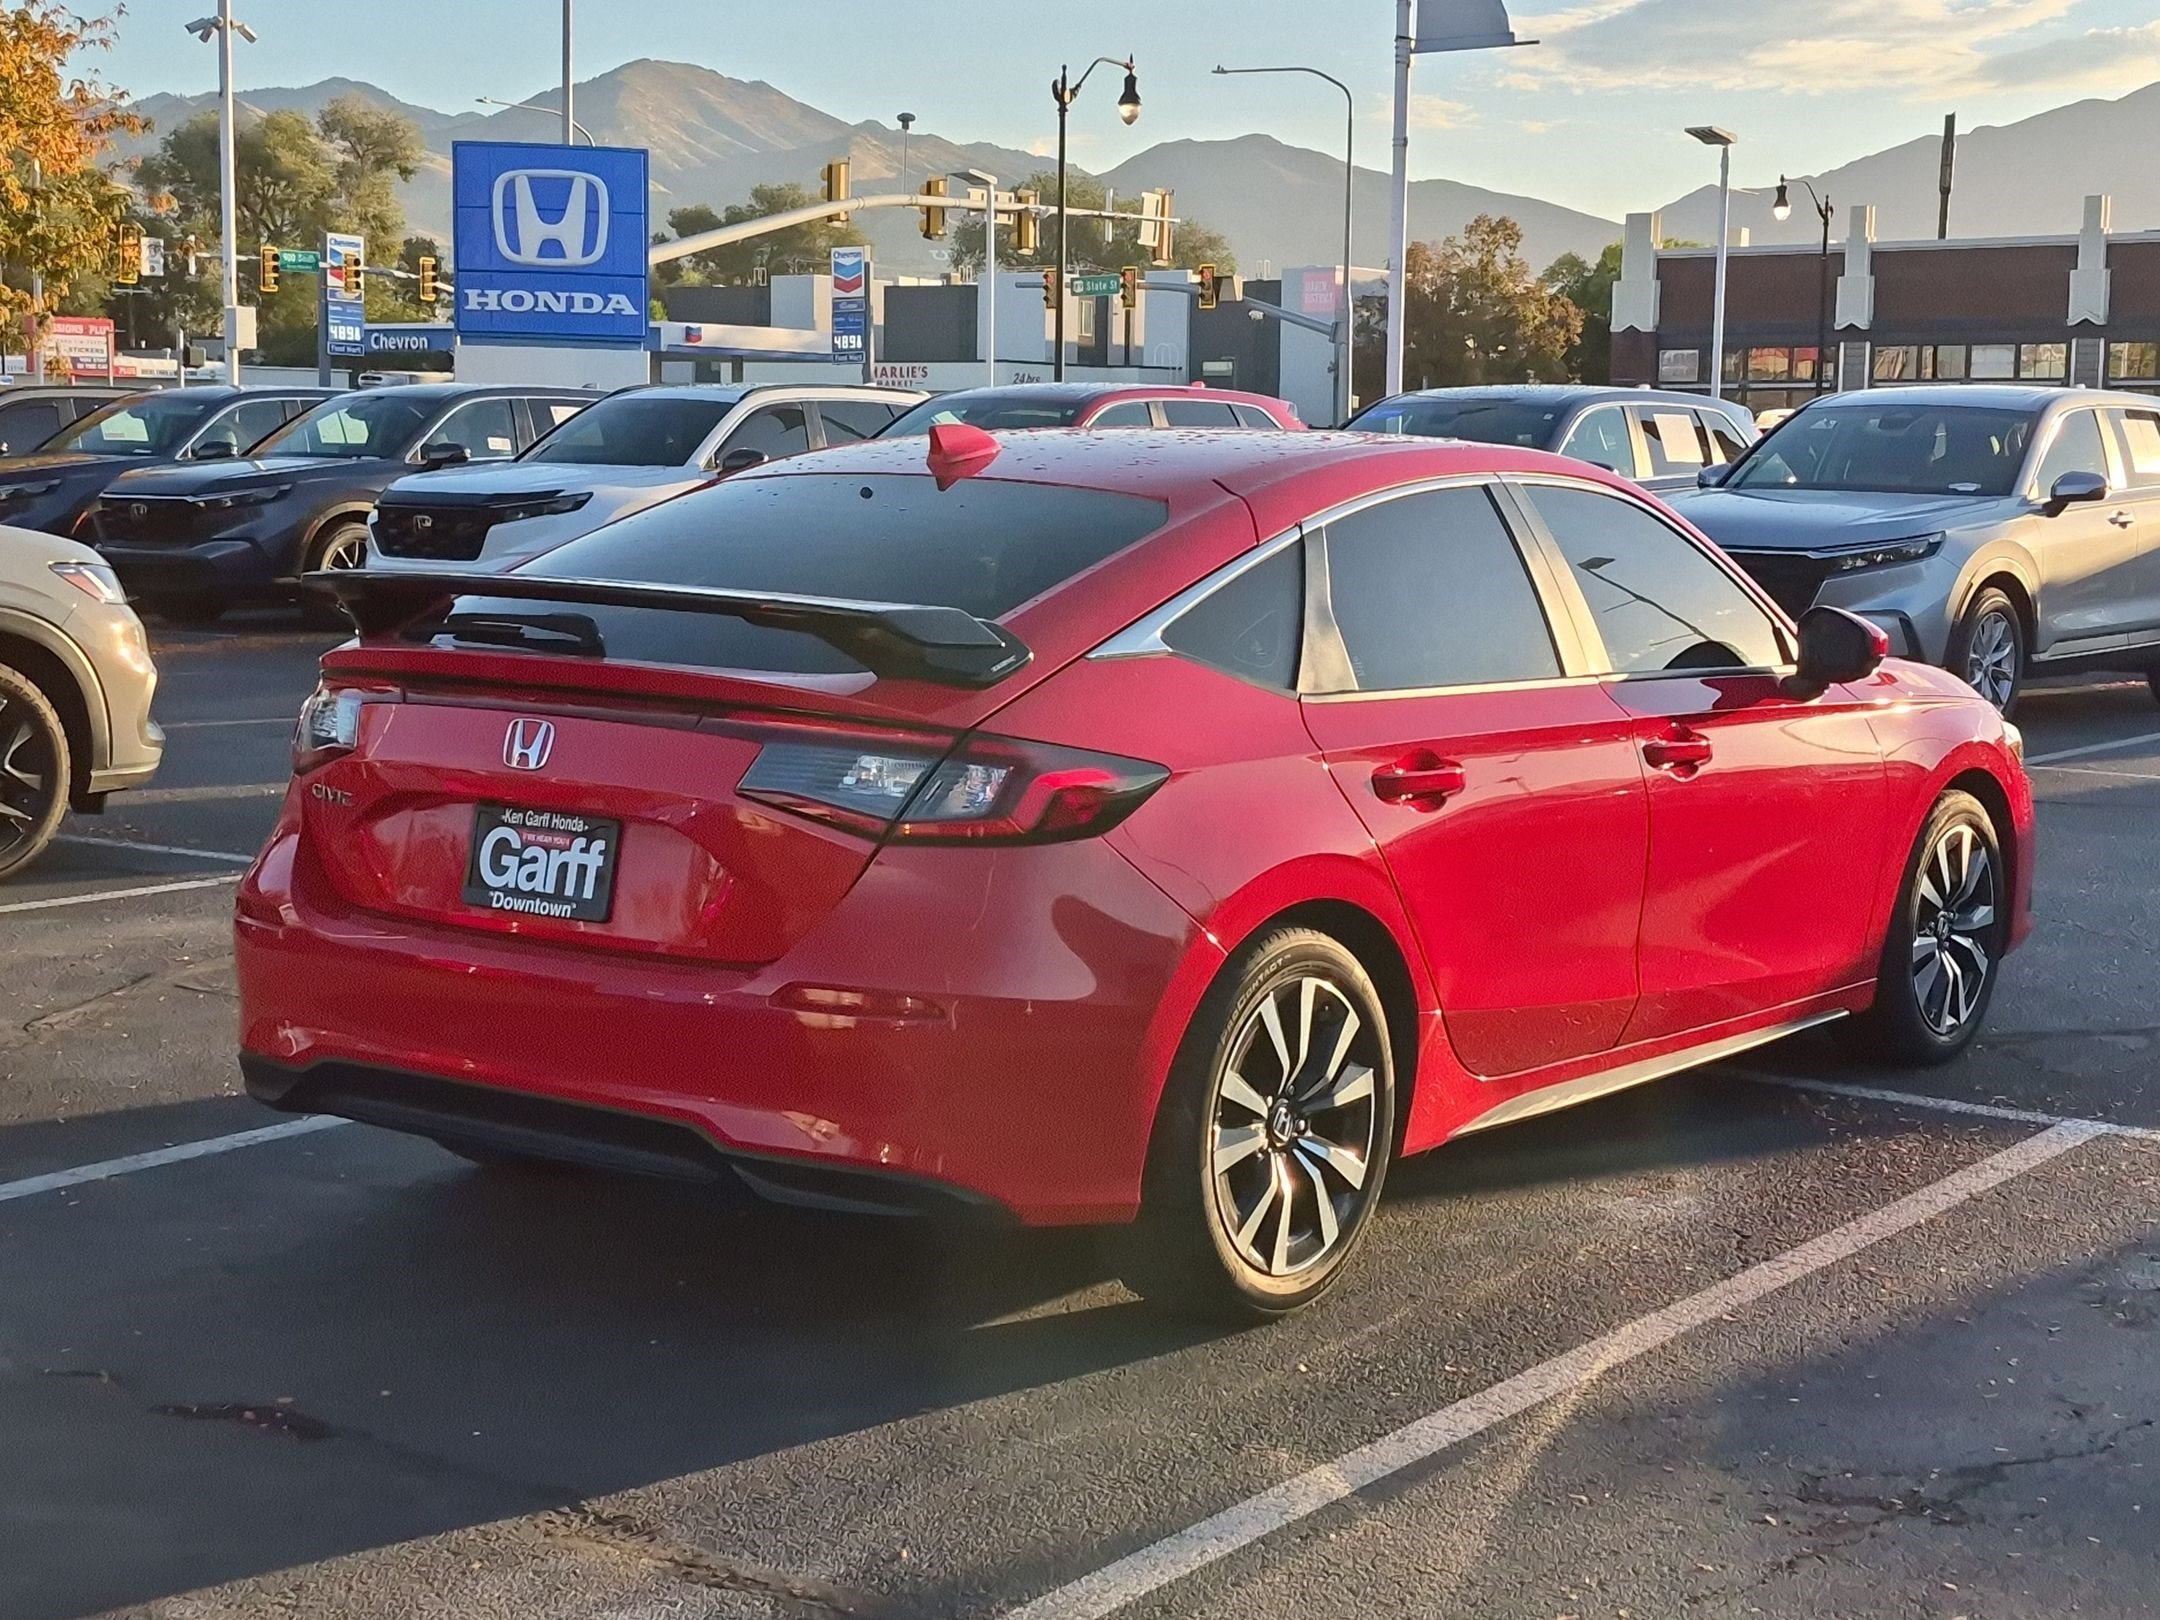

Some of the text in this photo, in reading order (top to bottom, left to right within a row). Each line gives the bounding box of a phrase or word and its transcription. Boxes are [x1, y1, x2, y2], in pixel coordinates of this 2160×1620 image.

[1086, 280, 1107, 291] State
[1109, 279, 1118, 290] St
[463, 288, 640, 316] HONDA
[370, 332, 428, 350] Chevron
[312, 783, 353, 807] CIVIC
[503, 808, 584, 832] Ken Garff Honda
[479, 826, 606, 899] Garff
[491, 891, 573, 918] Downtown
